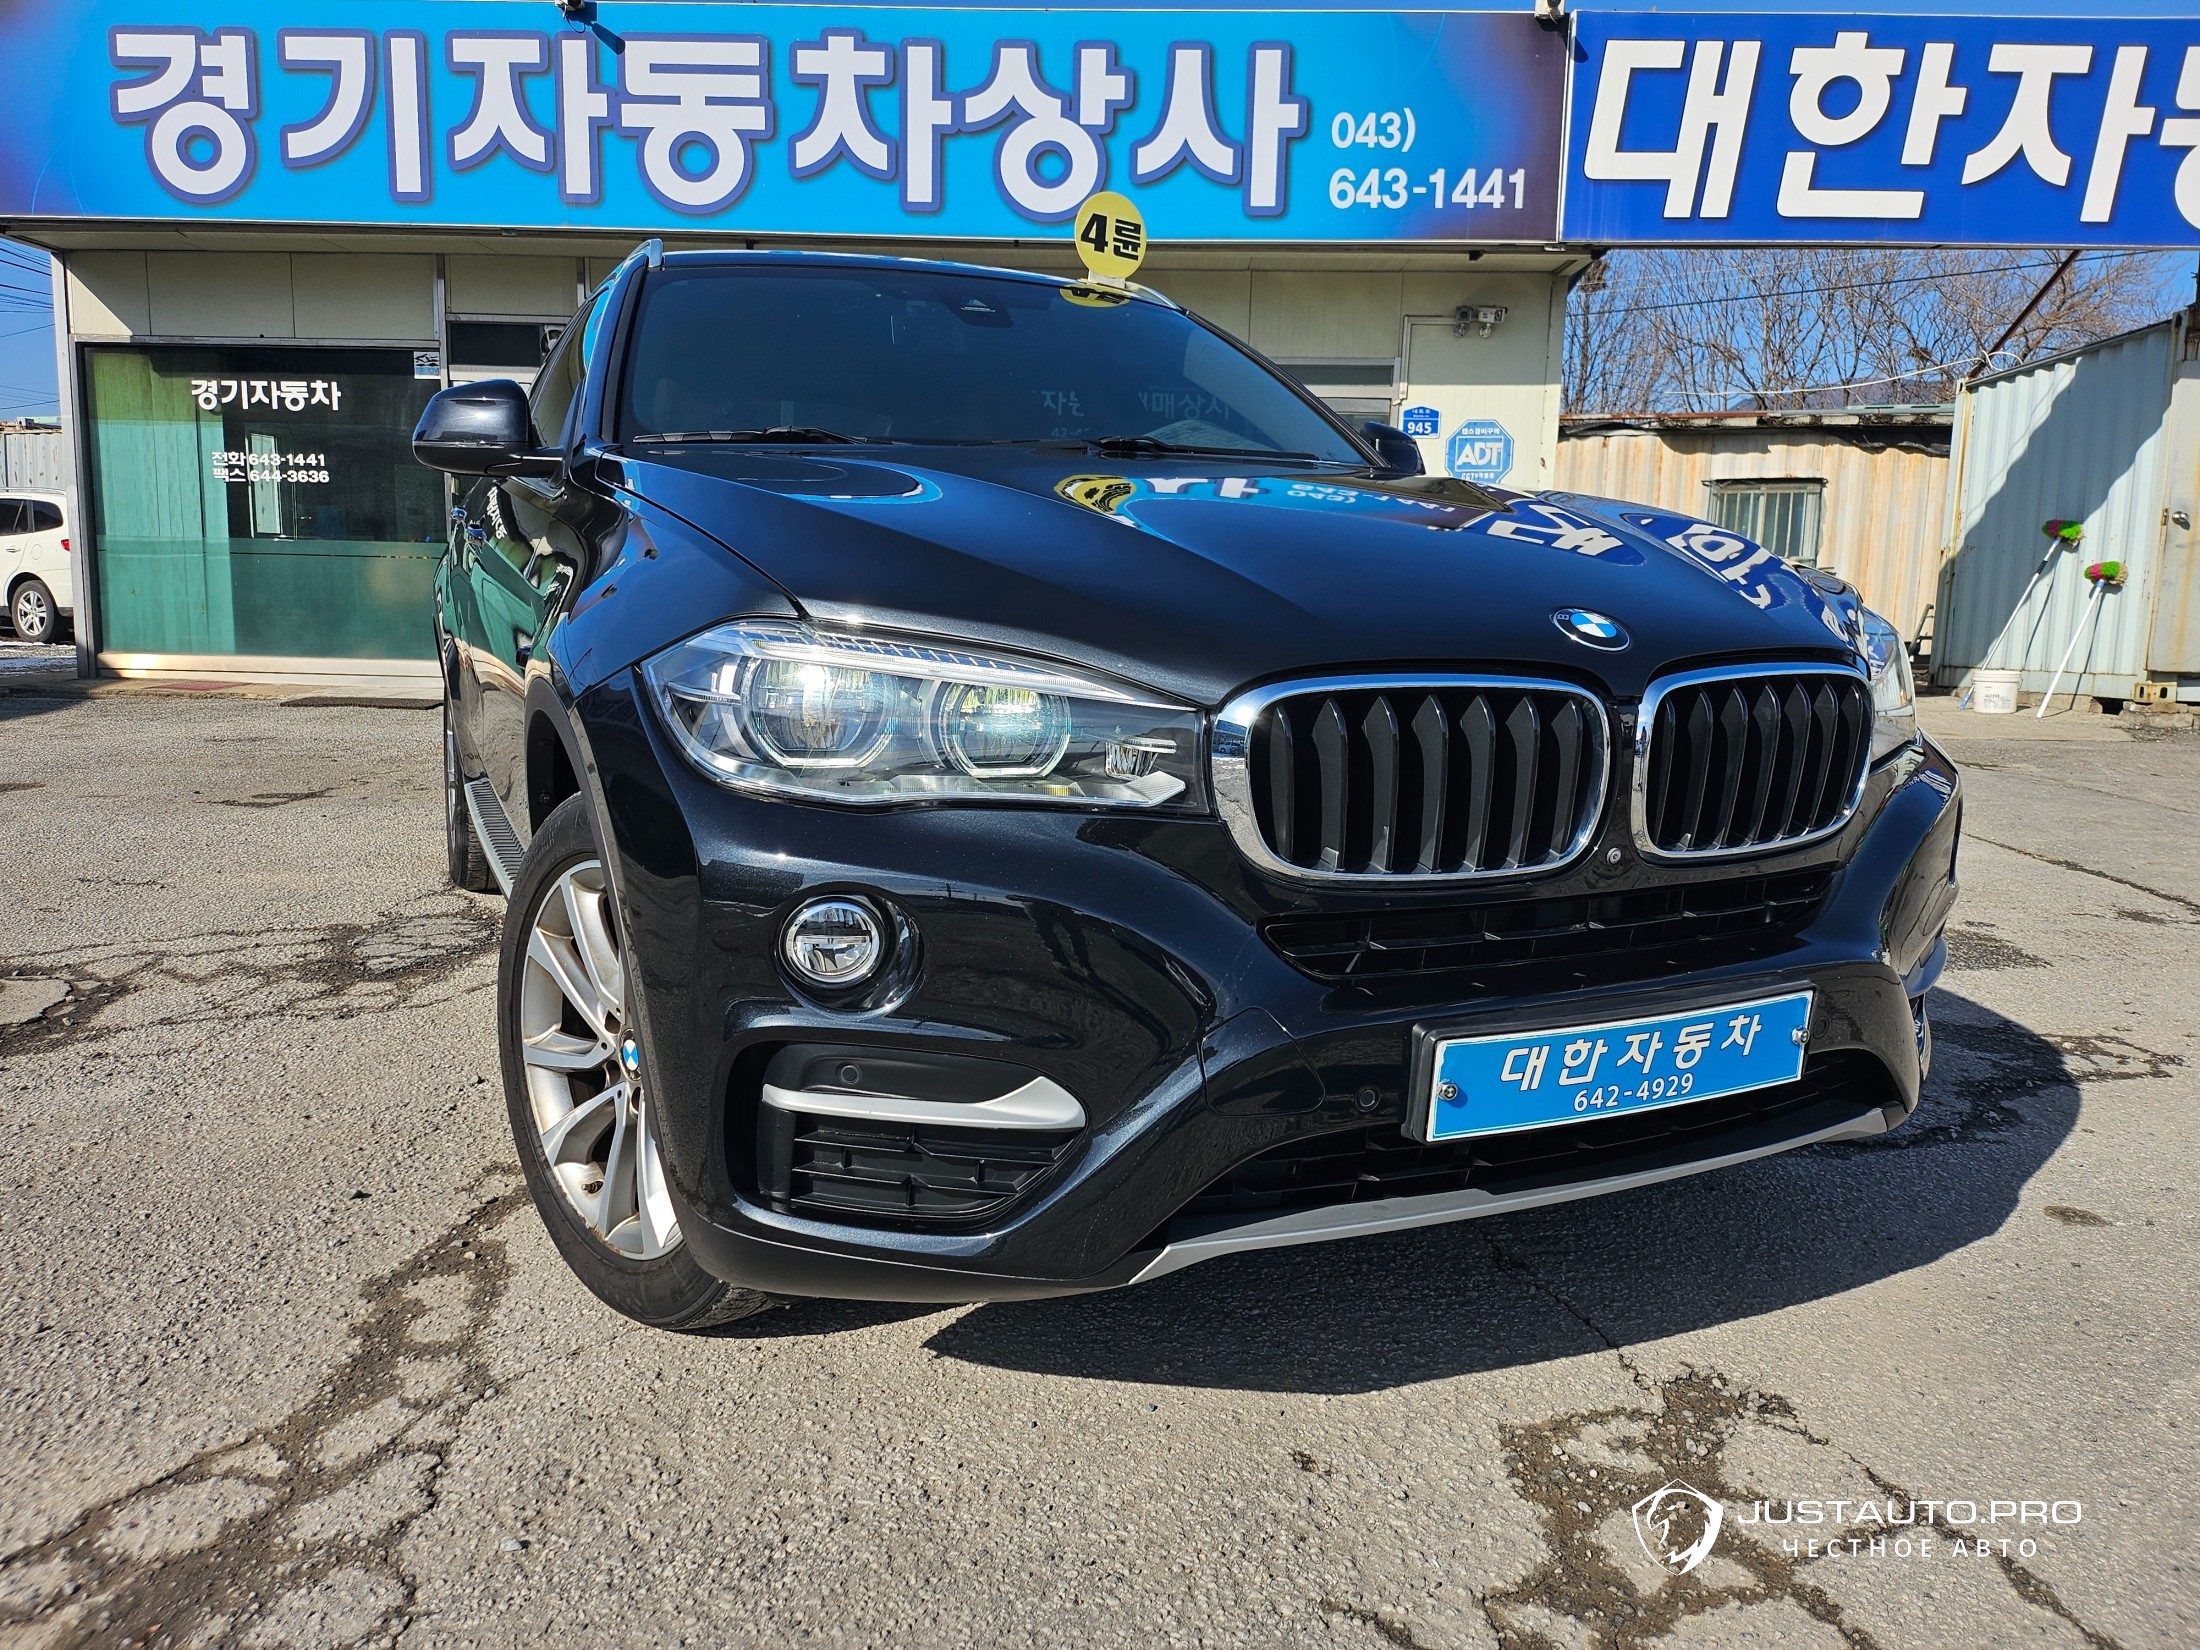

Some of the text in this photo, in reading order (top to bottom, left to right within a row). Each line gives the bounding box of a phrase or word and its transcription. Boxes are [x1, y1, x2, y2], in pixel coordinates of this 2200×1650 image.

[112, 31, 1303, 218] 경기자동차상사
[1331, 108, 1416, 153] 043)
[1328, 167, 1526, 210] 643-1441
[1080, 212, 1142, 262] 4륜
[190, 379, 342, 412] 경기자동차
[1407, 421, 1432, 434] 945
[211, 451, 326, 467] 전화 643-1441
[1456, 442, 1502, 466] ADT
[212, 467, 330, 484] 팩스 644-3636
[1499, 1012, 1763, 1093] 대한자동차
[1572, 1072, 1694, 1113] 642-4929
